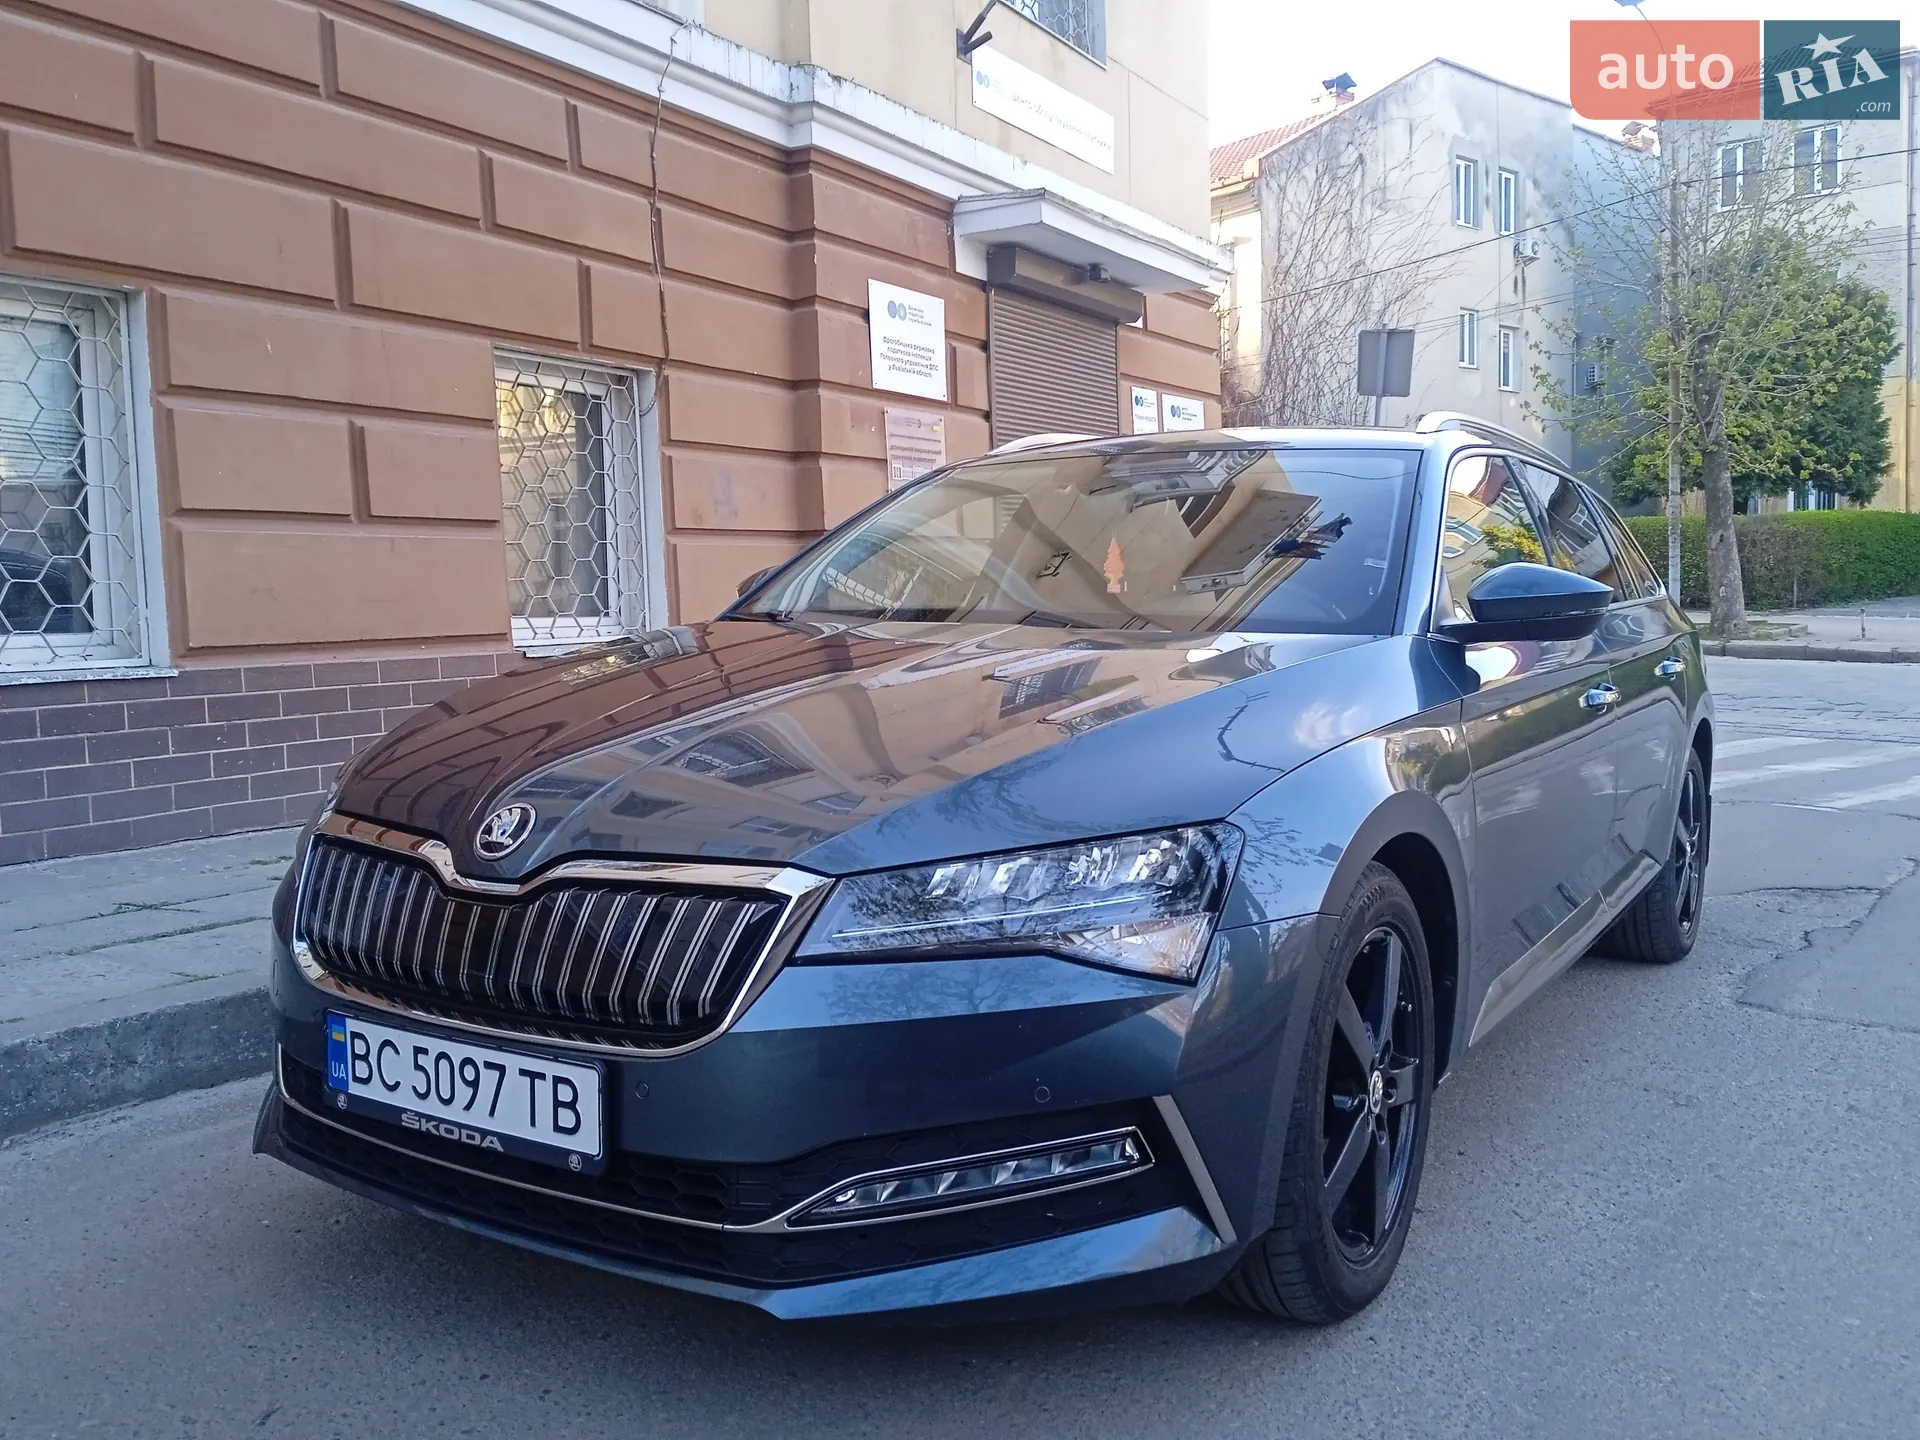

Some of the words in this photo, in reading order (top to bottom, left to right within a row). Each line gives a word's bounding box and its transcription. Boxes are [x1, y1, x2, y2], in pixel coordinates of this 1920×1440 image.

[883, 336, 913, 349] Дрогобицька
[913, 344, 935, 354] державна
[887, 346, 911, 357] податкова
[880, 352, 904, 364] Головного
[929, 363, 939, 372] ДПС
[331, 1062, 347, 1081] UA
[349, 1030, 402, 1092] BC
[411, 1044, 507, 1118] 5097
[518, 1067, 582, 1137] TB
[401, 1111, 504, 1152] ŠKODA
